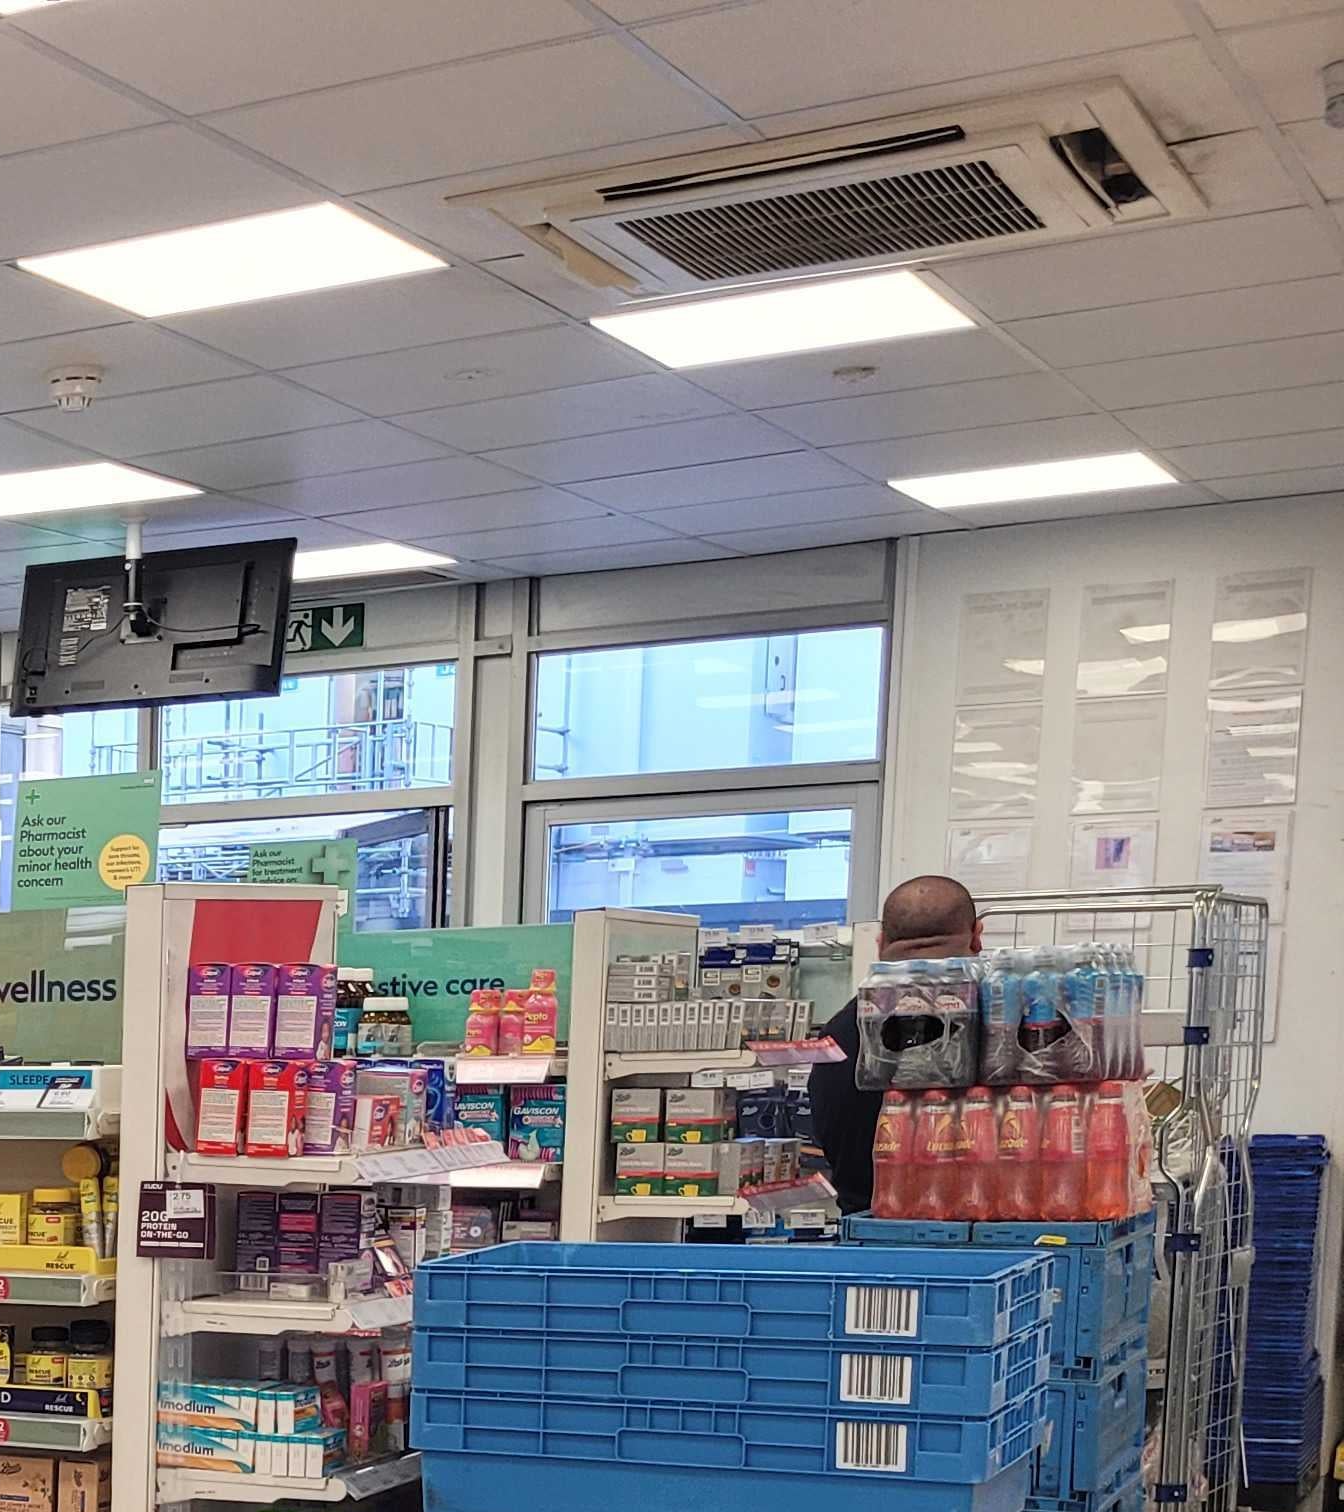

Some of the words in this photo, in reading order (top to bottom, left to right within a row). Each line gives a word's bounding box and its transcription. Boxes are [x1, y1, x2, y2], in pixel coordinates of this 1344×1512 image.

[22, 815, 44, 827] Ask
[46, 815, 66, 826] our
[19, 827, 87, 842] Pharmacist
[19, 846, 54, 857] about
[57, 845, 84, 860] your
[18, 861, 51, 872] minor
[54, 858, 92, 871] health
[17, 877, 63, 888] concern
[446, 975, 505, 996] care
[513, 1105, 560, 1117] GAVISCON
[141, 1222, 178, 1232] PROTEIN
[140, 1230, 189, 1240] ON-THE-GO
